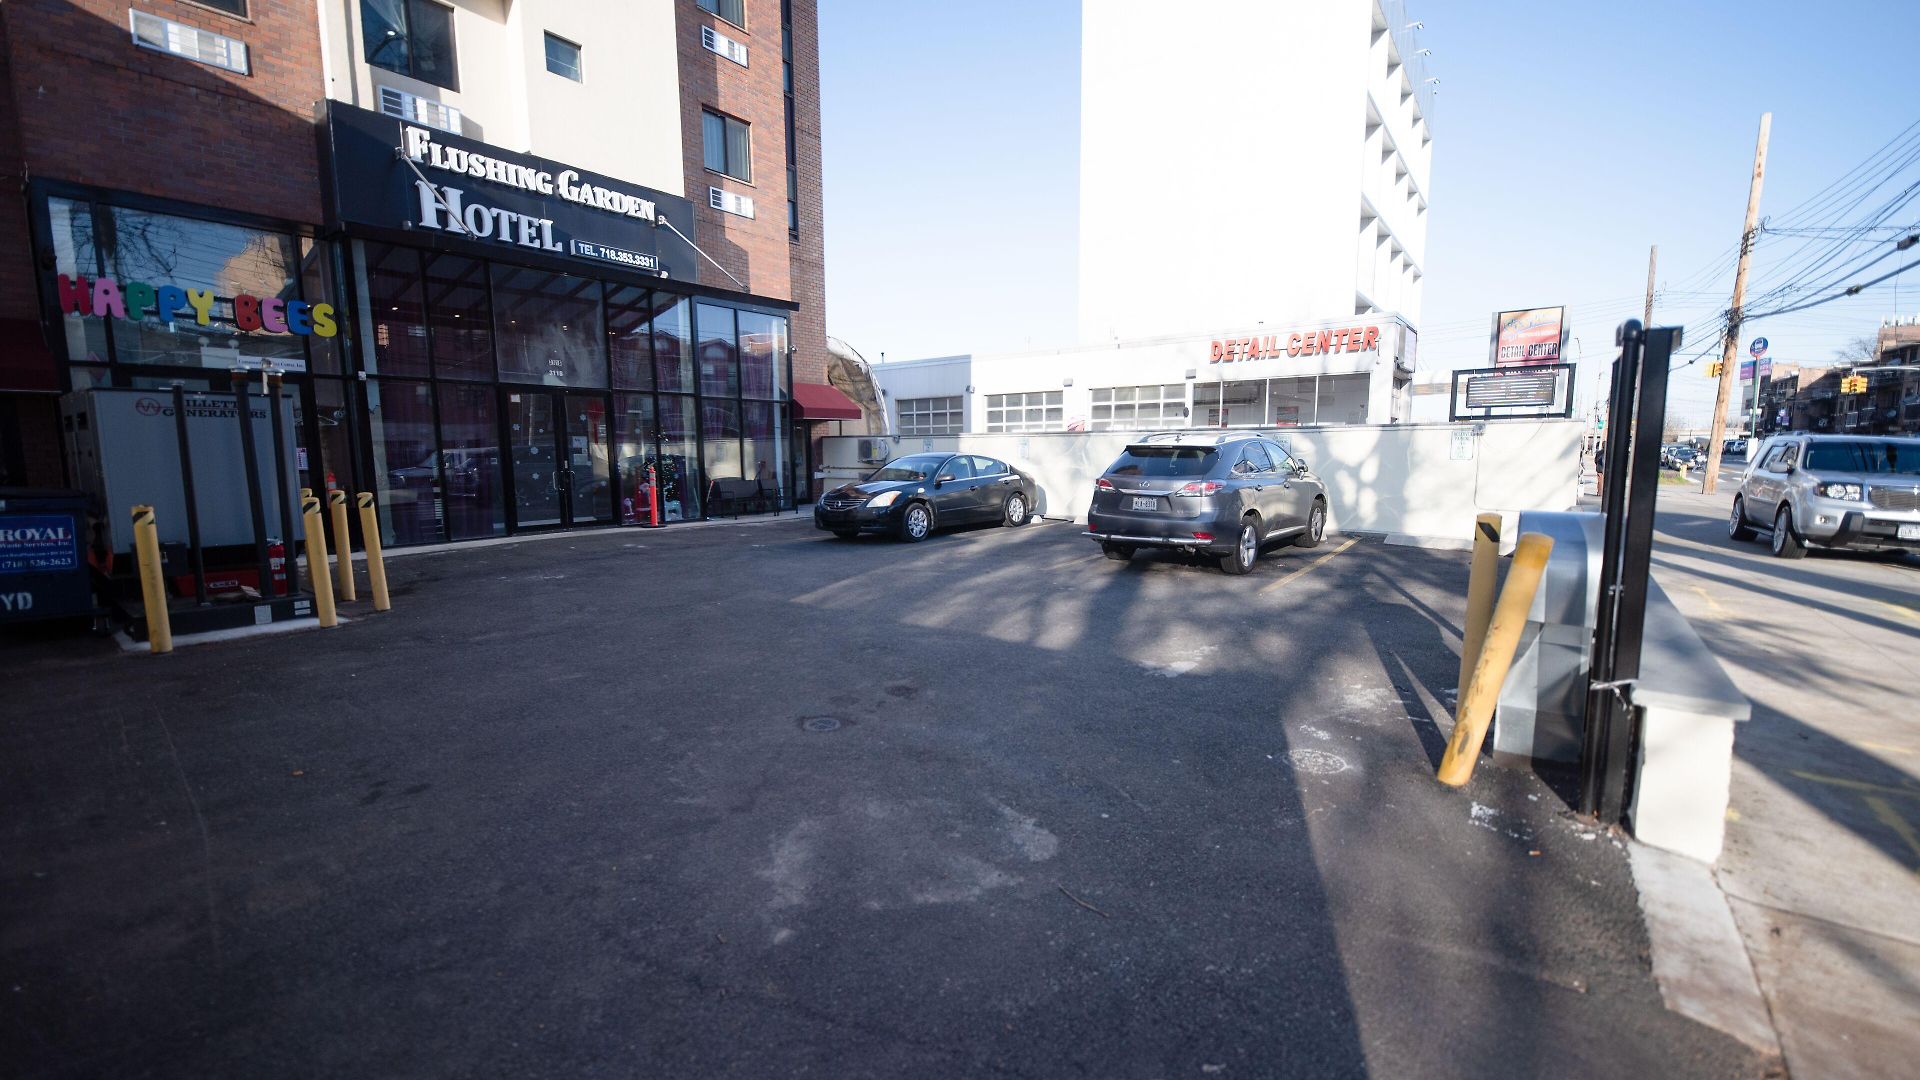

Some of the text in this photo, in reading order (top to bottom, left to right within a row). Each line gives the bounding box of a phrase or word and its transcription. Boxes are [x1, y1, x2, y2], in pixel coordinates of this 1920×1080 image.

[406, 125, 657, 222] FLUSHING GARDEN
[415, 179, 563, 252] HOTEL
[578, 242, 655, 268] TEL. 718.353.3331
[58, 273, 338, 338] HAPPY BEES
[1209, 325, 1380, 365] DETAIL CENTER
[1501, 342, 1558, 359] DETAIL CENTER
[162, 408, 267, 419] GNERATRS
[0, 527, 72, 542] ROYAL
